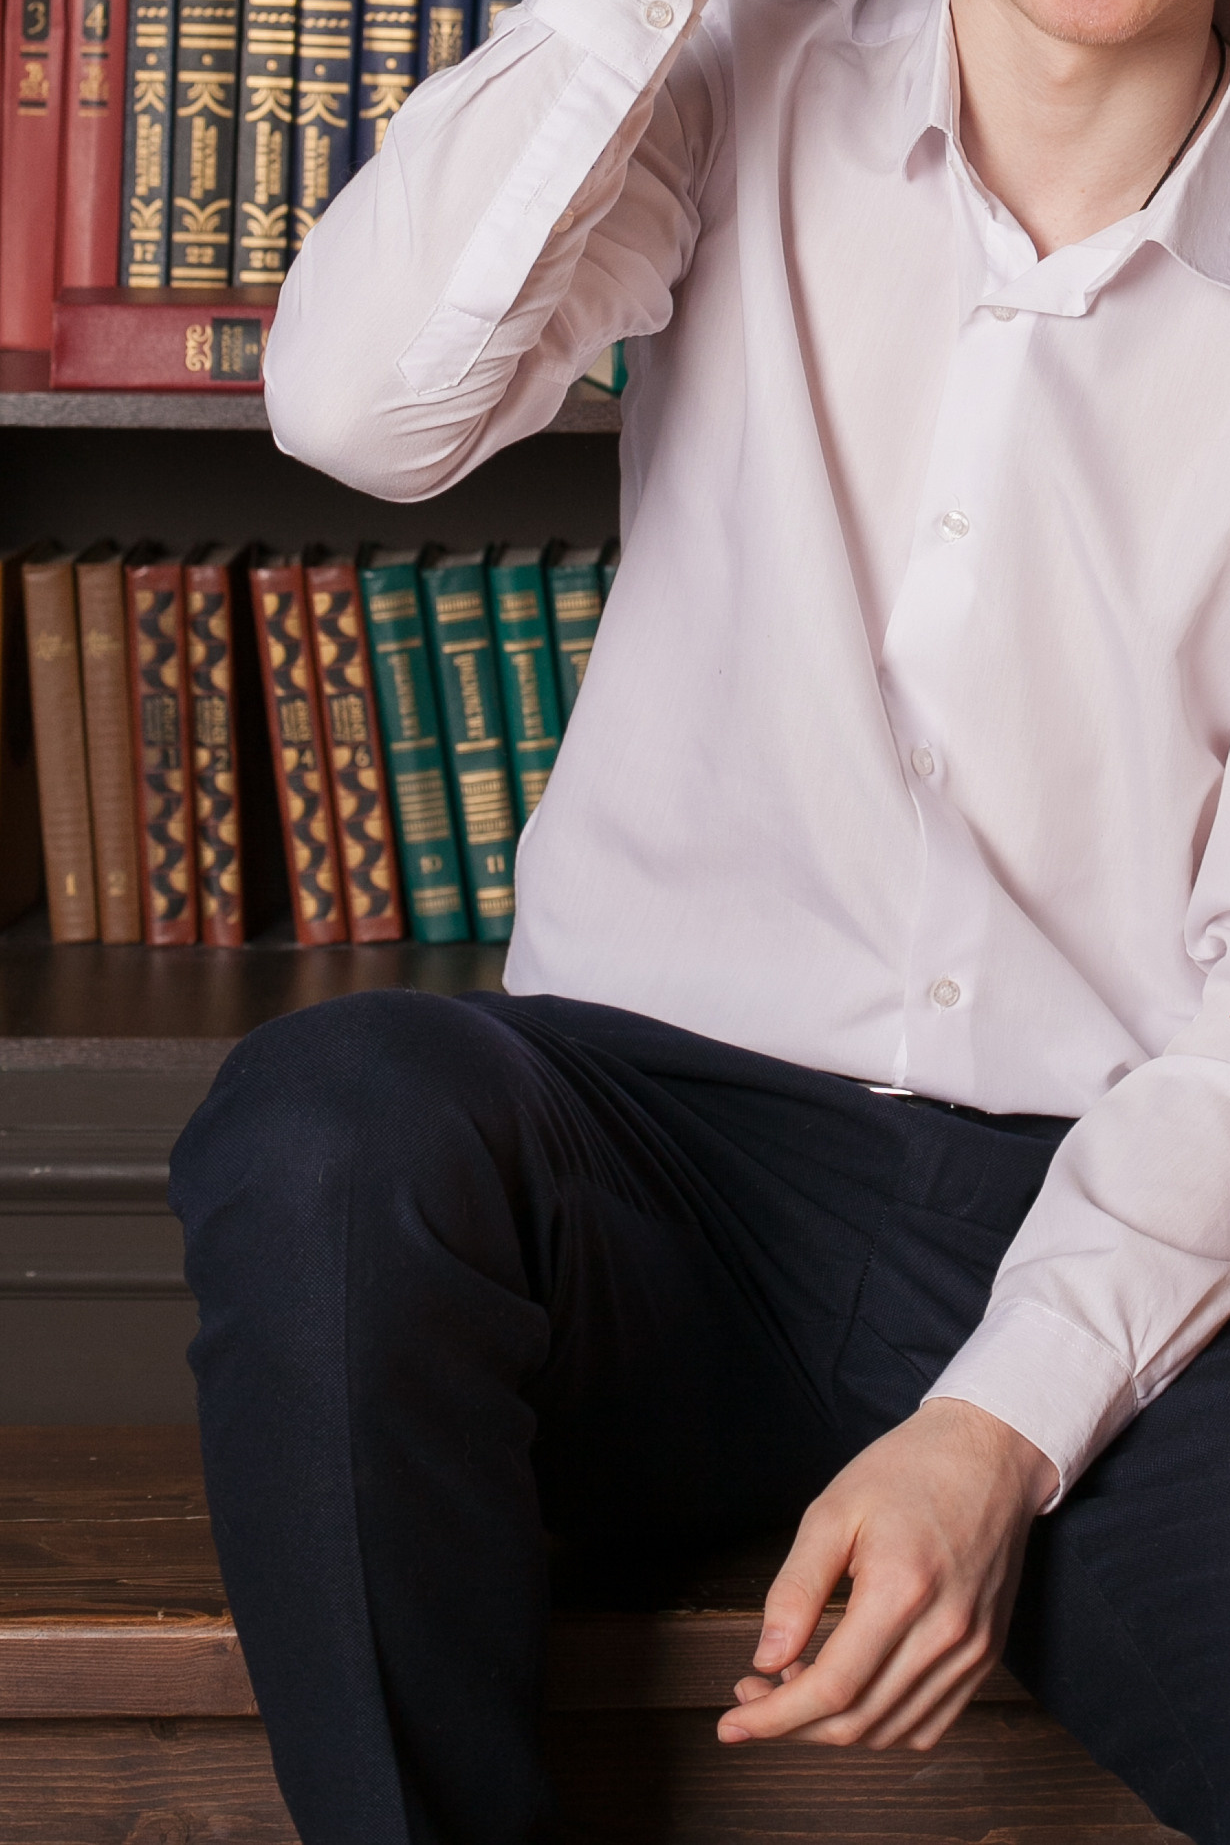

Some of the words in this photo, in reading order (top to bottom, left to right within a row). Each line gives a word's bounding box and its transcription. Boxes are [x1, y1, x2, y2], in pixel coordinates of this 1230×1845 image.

[27, 1, 47, 35] 3
[85, 2, 108, 36] 4
[355, 746, 371, 768] 6
